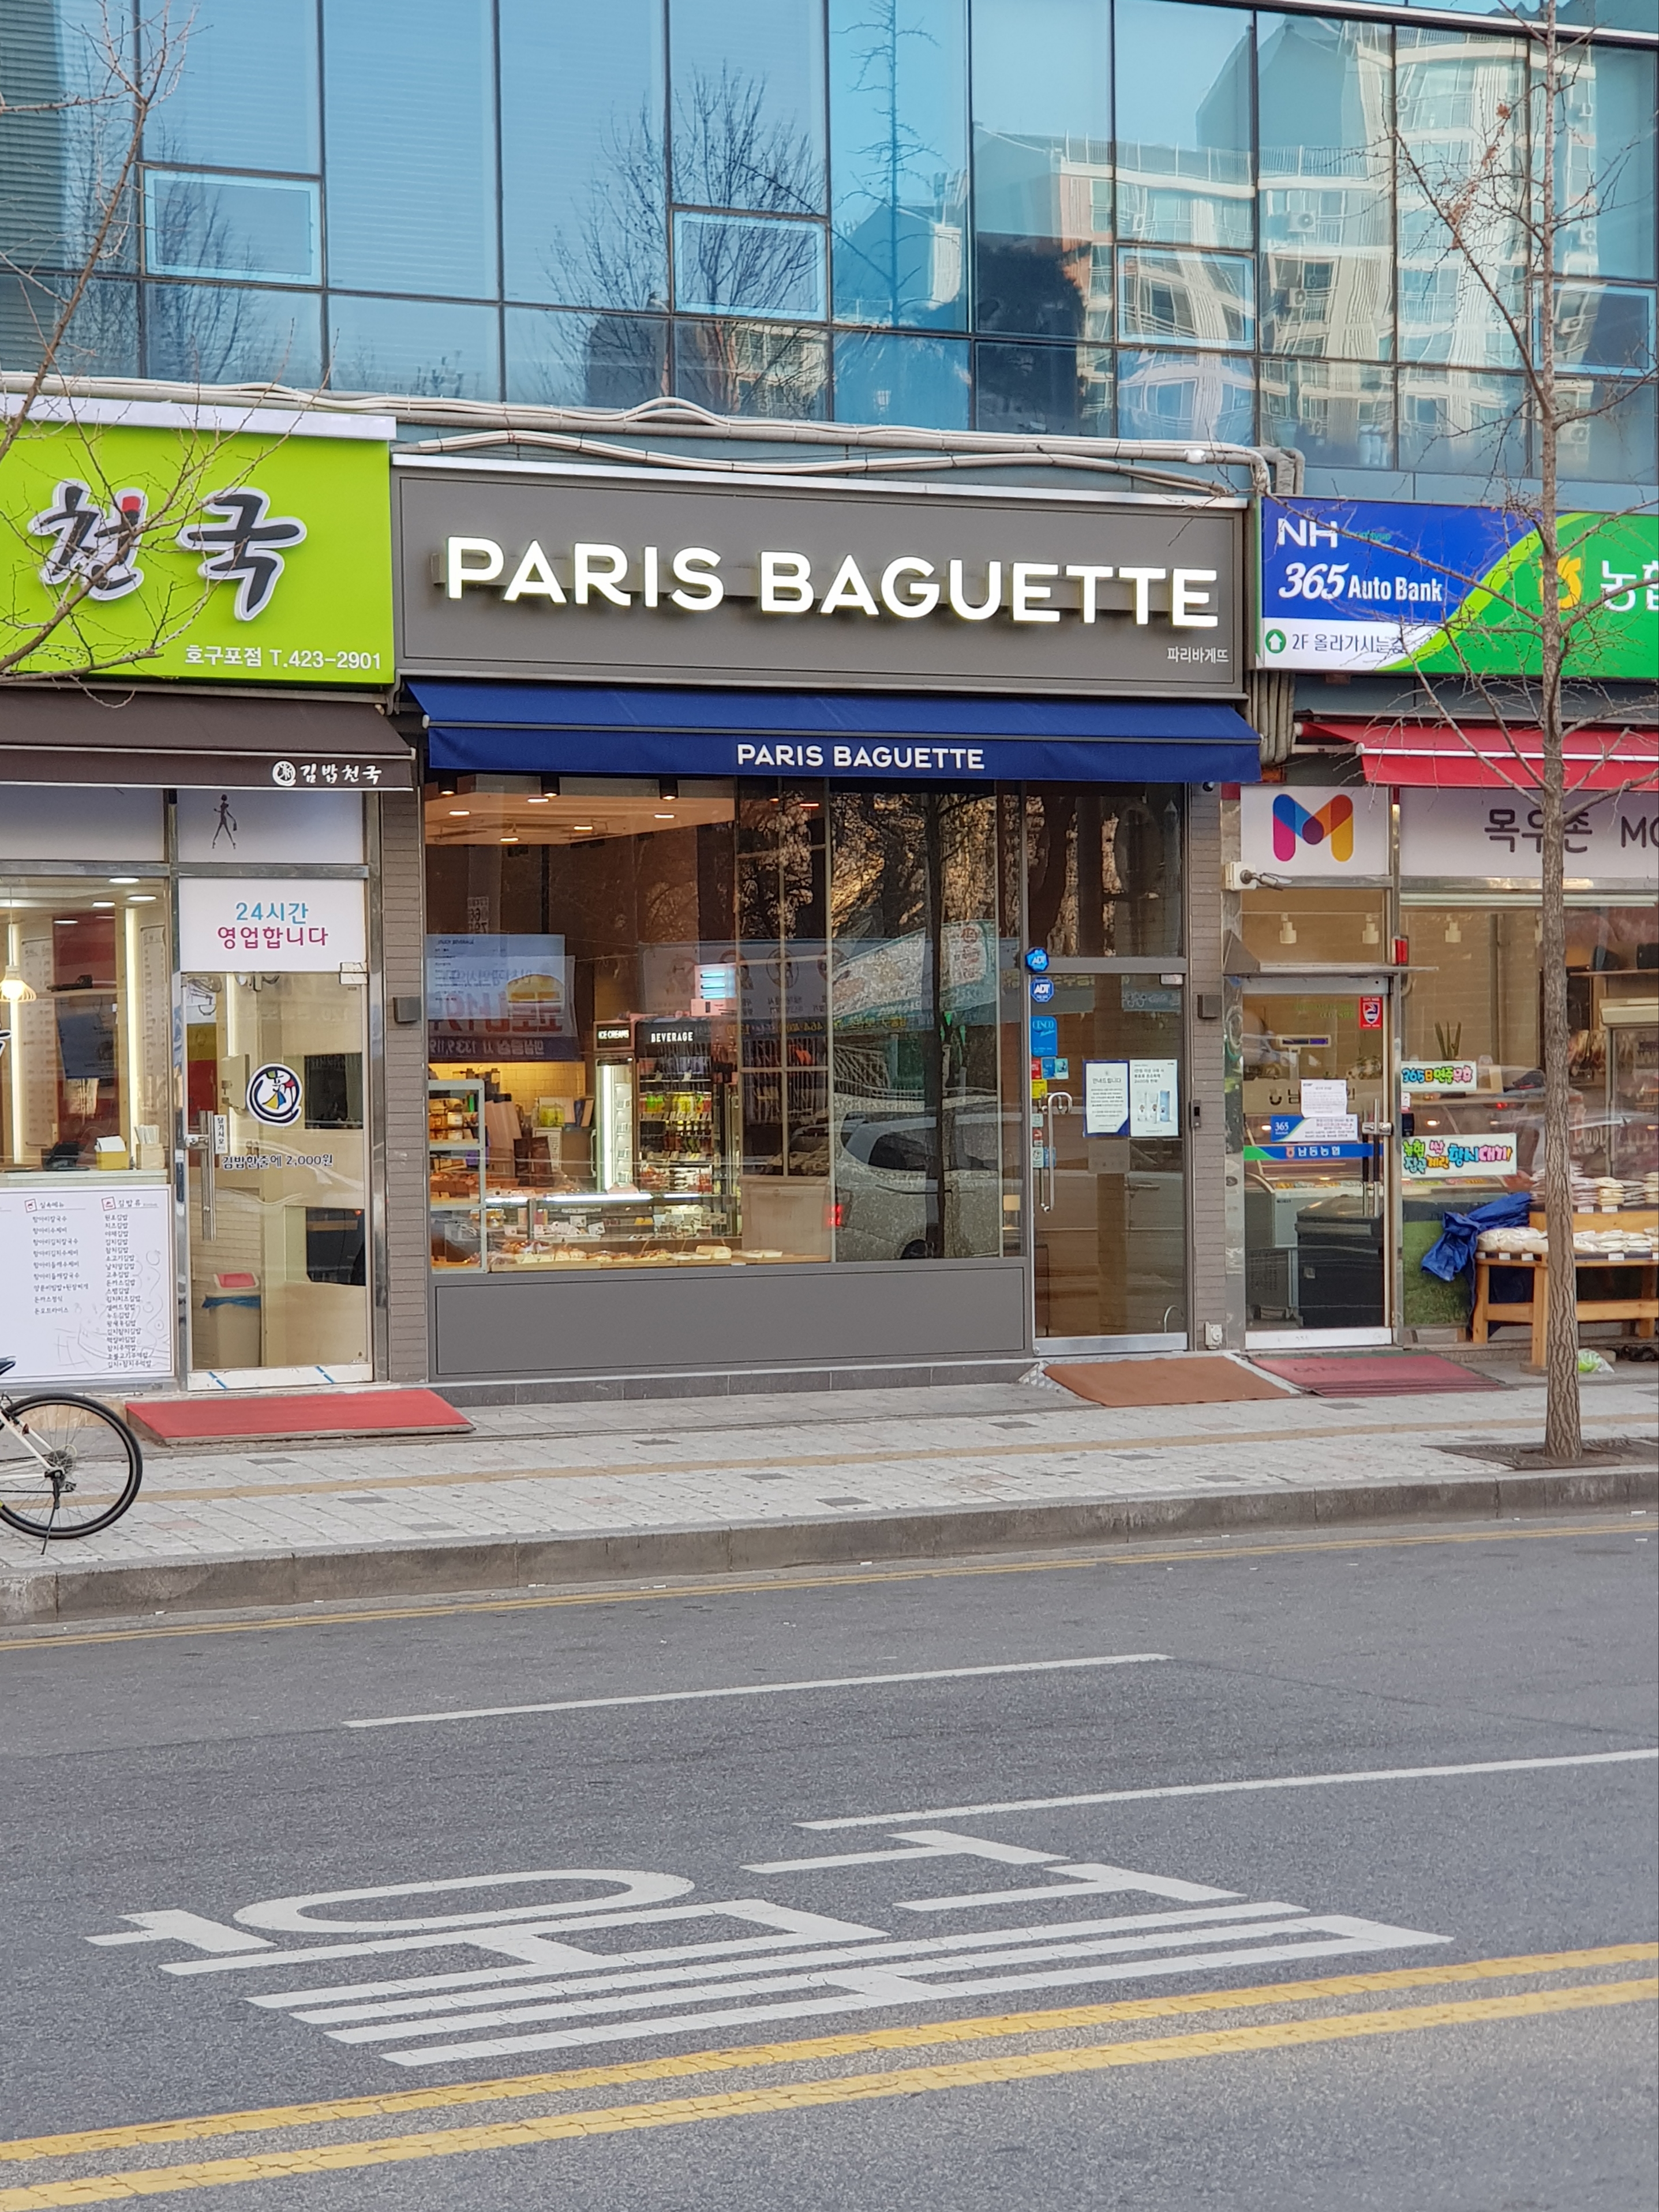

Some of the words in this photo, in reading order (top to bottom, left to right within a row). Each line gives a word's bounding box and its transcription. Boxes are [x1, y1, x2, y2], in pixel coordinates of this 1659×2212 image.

[1278, 518, 1338, 548] NH
[447, 535, 725, 612] PARIS
[759, 550, 1219, 628] BAGUETTE
[1278, 562, 1350, 600] 365
[1347, 575, 1392, 601] Auto
[1395, 576, 1443, 602] Bank
[1292, 633, 1309, 650] 2F
[185, 644, 263, 668] 호구포점
[269, 648, 381, 670] T.423-2901
[1167, 646, 1229, 664] 파리바게뜨
[737, 744, 823, 767] PARIS
[834, 746, 985, 770] BAGUETTE
[300, 763, 382, 785] 김밥천국
[235, 902, 309, 924] 24시간
[216, 926, 329, 949] 영업합니다
[1034, 984, 1050, 994] ADT
[651, 1032, 693, 1043] BEVERAGE
[1275, 1122, 1289, 1131] 365
[286, 1154, 333, 1167] 2,000원
[1298, 1146, 1340, 1157] 남동농협
